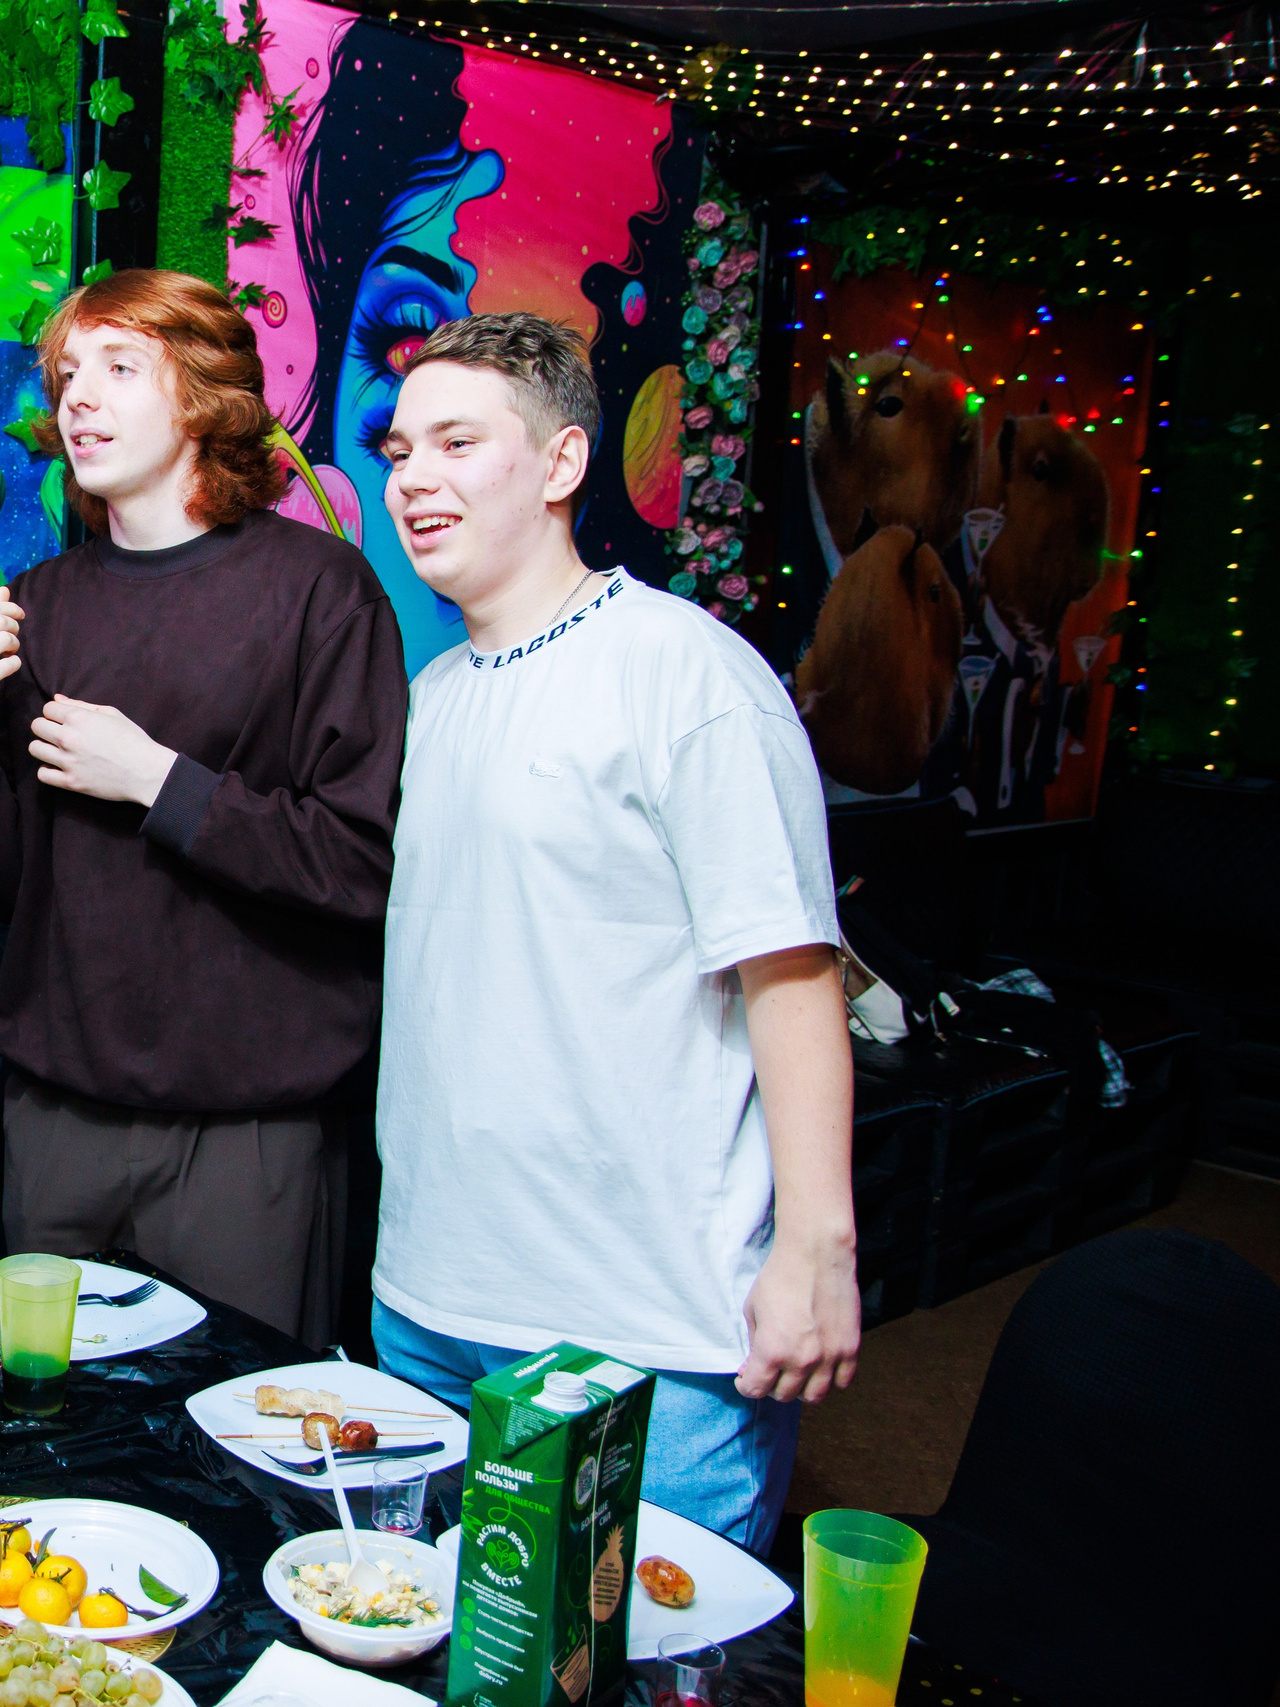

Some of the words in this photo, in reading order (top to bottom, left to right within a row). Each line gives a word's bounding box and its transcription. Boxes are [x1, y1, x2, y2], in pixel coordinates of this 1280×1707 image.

[493, 578, 624, 669] LACOSTE
[475, 1470, 519, 1492] ПОЛЬЗЫ
[484, 1460, 534, 1483] БОЛЬШЕ
[485, 1485, 503, 1498] ДЛЯ
[503, 1492, 551, 1515] ОБЩЕСТВА
[476, 1524, 507, 1546] РАСТИМ
[507, 1531, 530, 1568] ДОБРО
[480, 1562, 522, 1587] ВМЕСТЕ
[479, 1670, 503, 1686] dobry.ru
